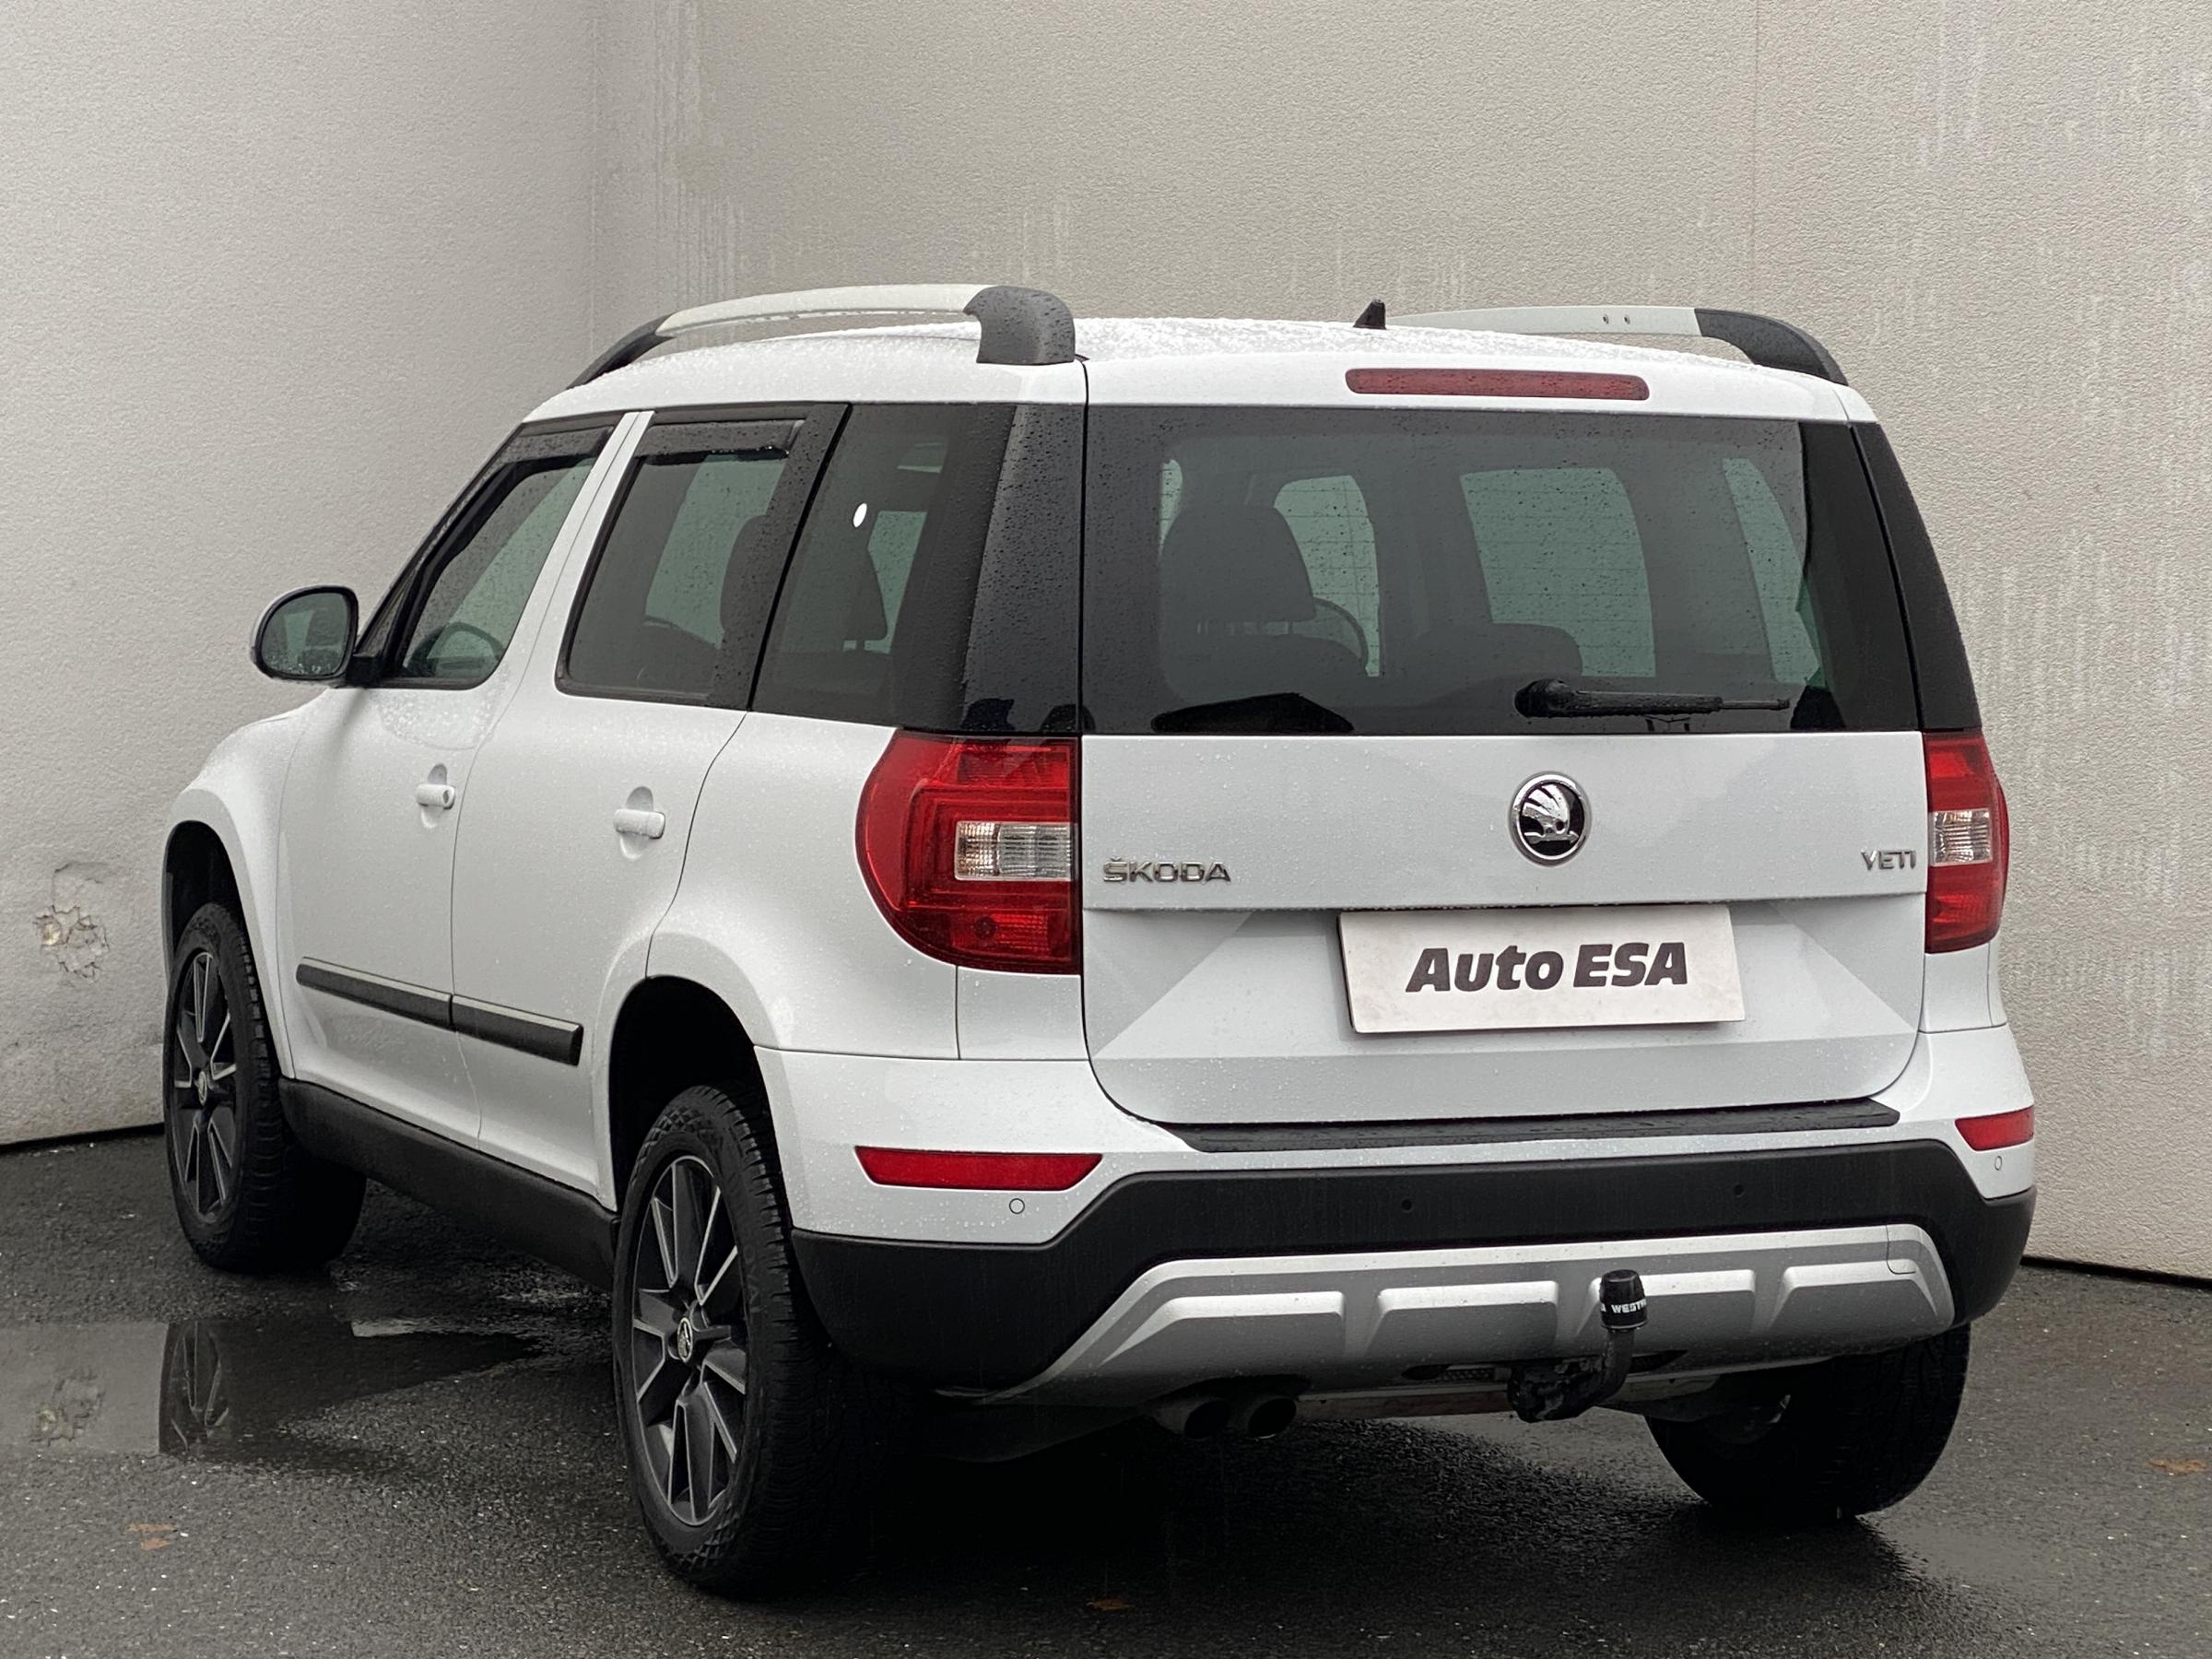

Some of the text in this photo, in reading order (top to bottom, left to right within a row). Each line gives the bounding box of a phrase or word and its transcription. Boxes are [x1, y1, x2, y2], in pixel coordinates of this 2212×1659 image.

[1103, 856, 1231, 883] ŠKODA
[1405, 941, 1688, 993] Auto ESA
